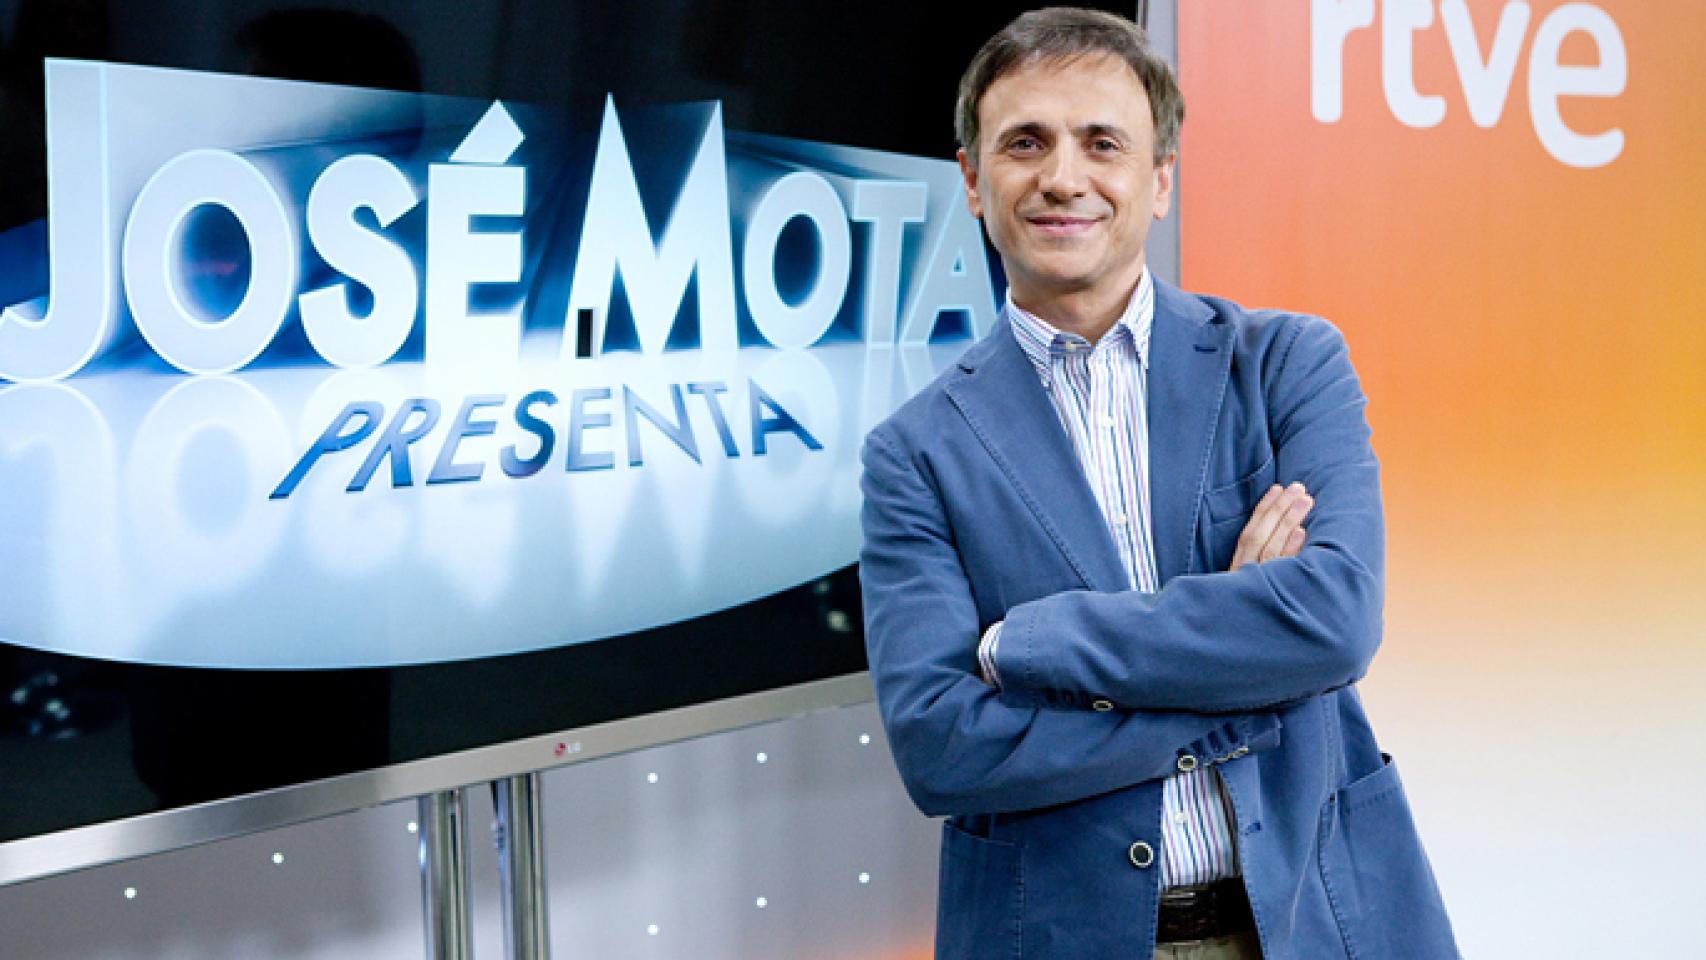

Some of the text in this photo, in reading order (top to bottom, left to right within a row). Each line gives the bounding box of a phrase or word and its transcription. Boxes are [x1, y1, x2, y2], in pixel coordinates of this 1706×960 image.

[1310, 0, 1627, 168] rtve
[0, 57, 998, 384] JOSÉ MOTA
[268, 378, 824, 500] PRESENTA
